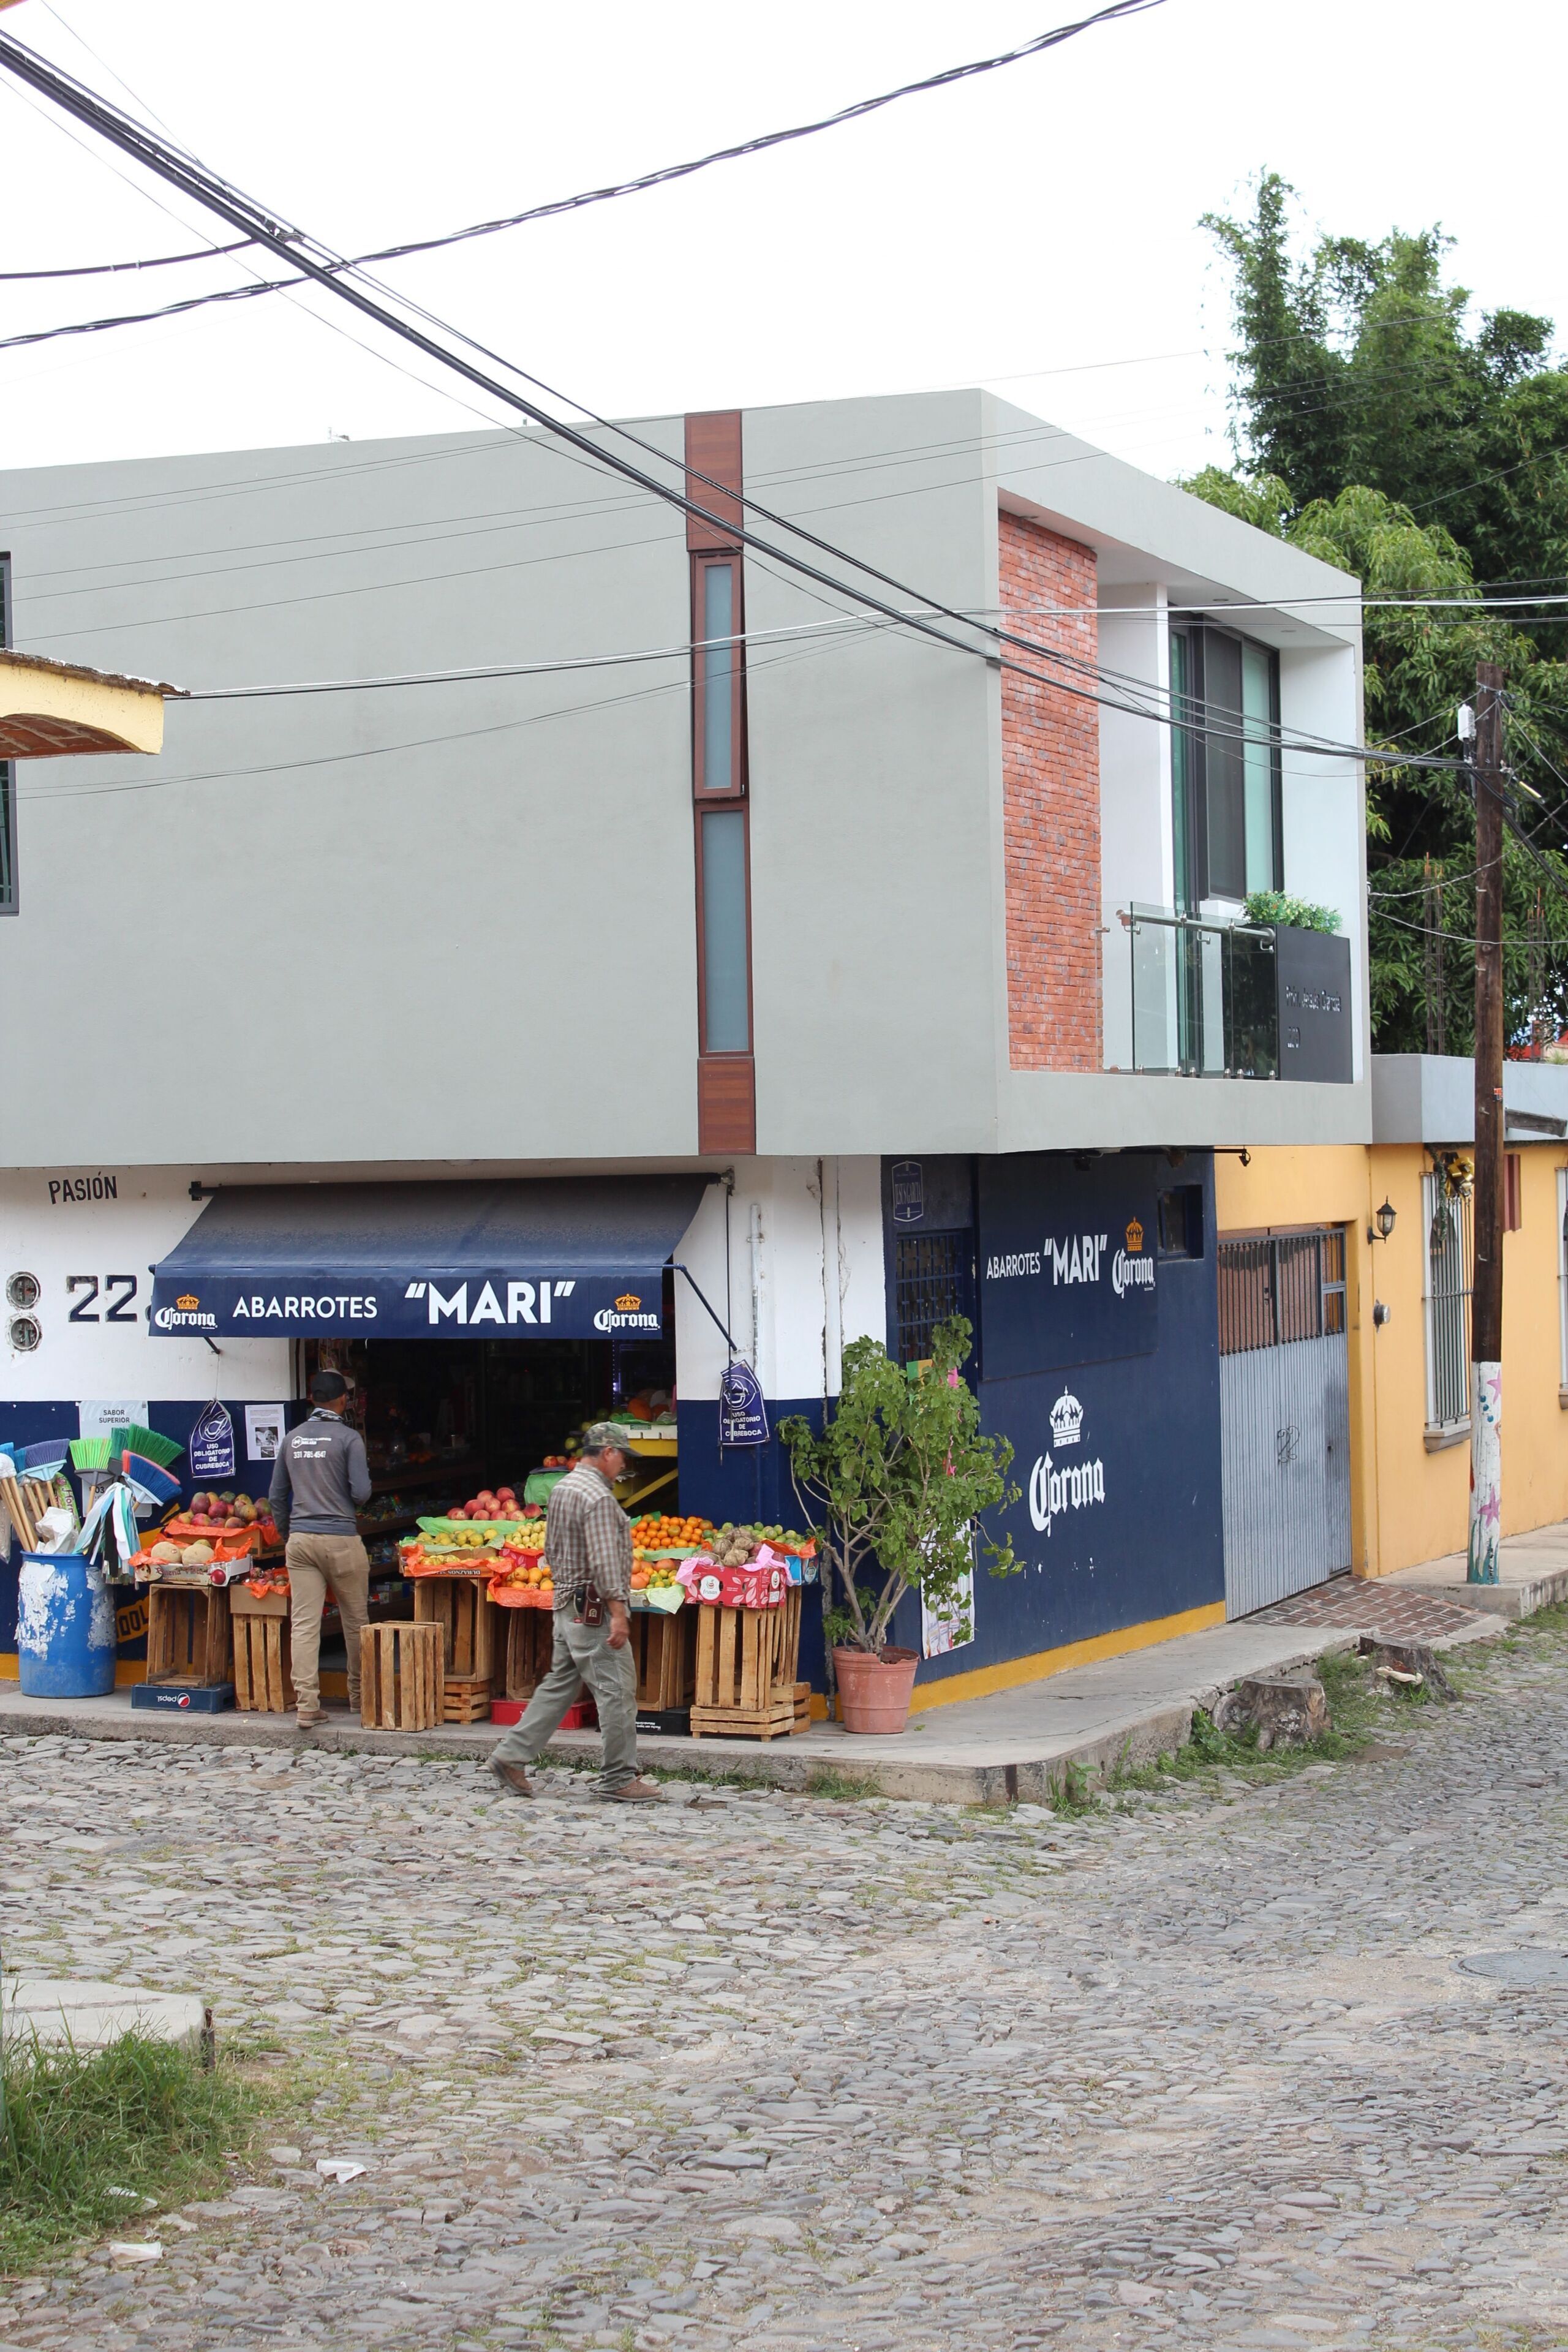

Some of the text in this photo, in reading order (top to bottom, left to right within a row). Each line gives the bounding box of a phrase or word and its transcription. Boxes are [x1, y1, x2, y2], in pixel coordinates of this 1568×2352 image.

[48, 1171, 118, 1205] PASIÓN
[986, 1234, 1107, 1286] ABARROTES "MARI"
[1112, 1248, 1155, 1299] Corona
[66, 1275, 153, 1323] 22
[154, 1306, 216, 1330] Corona
[232, 1280, 576, 1325] ABARROTES "MARI"
[593, 1308, 659, 1333] Corona
[194, 1448, 230, 1457] OBLIGATORIO
[195, 1461, 230, 1470] CUBREBOCA
[1029, 1450, 1106, 1537] Corona
